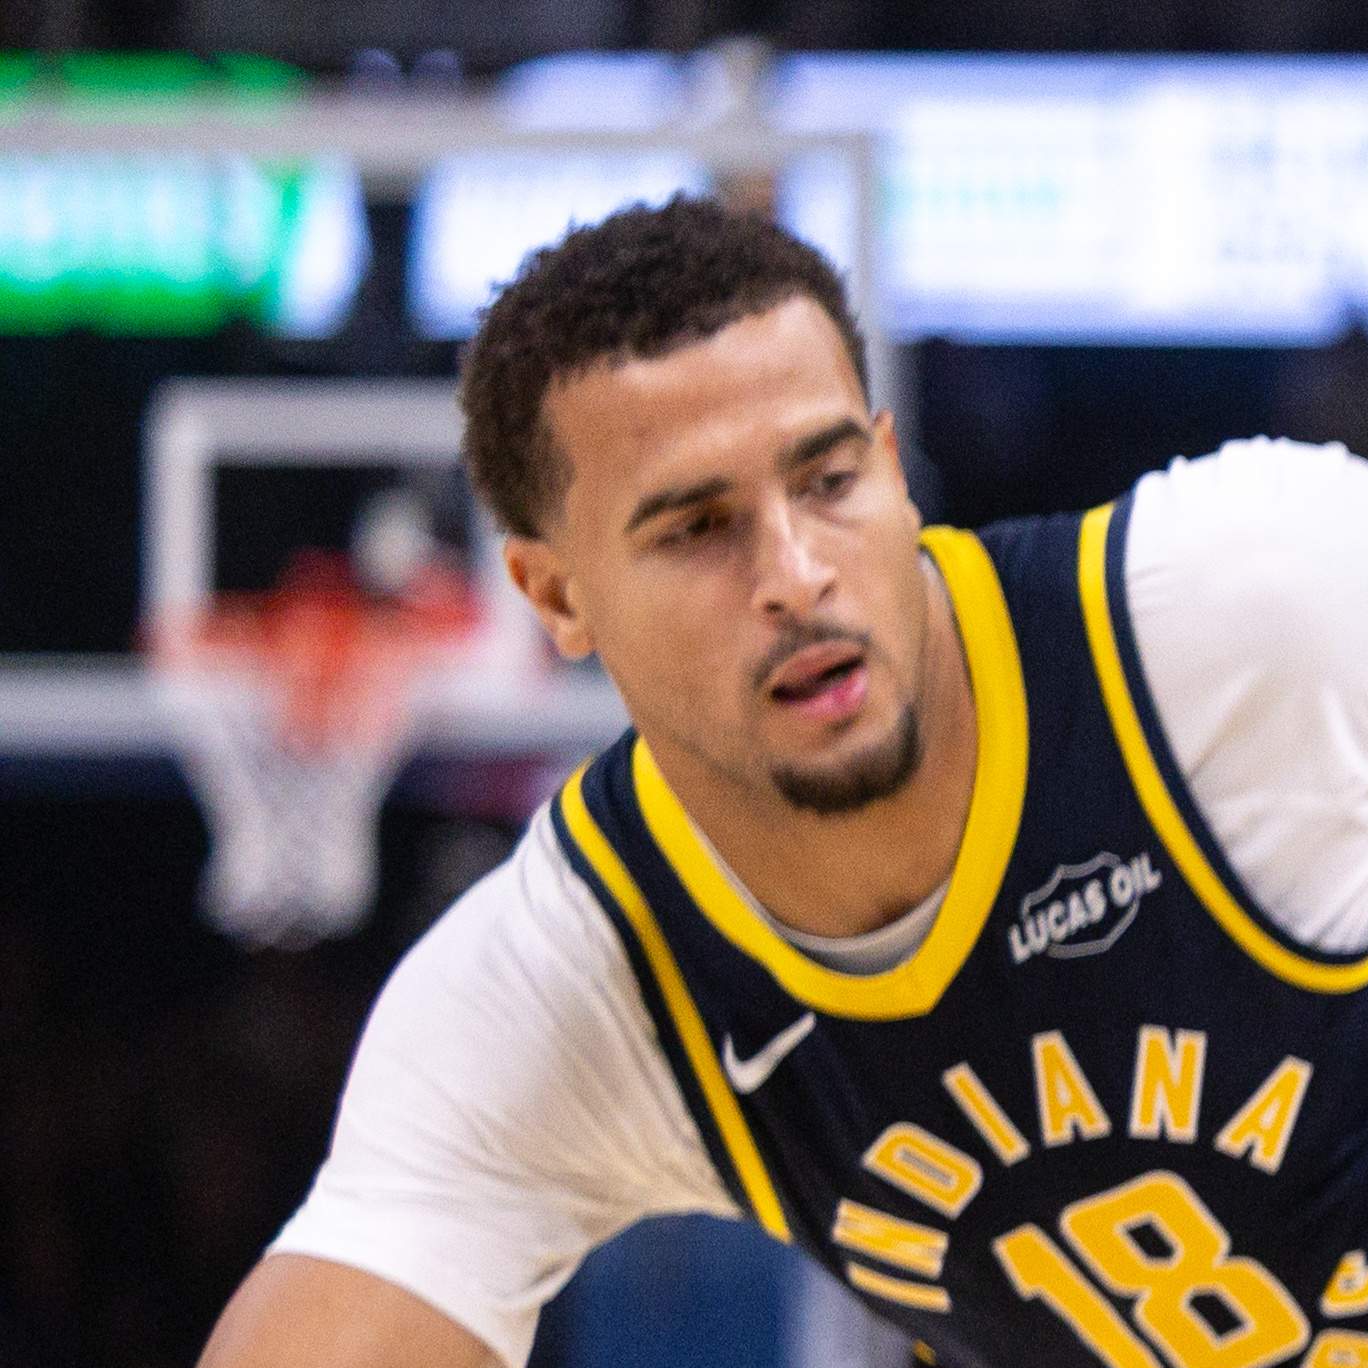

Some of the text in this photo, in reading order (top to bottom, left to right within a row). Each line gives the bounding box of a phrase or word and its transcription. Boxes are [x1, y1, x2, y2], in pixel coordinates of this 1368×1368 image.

[1008, 852, 1163, 964] LUCAS OIL
[834, 1025, 1313, 1312] INDIANA
